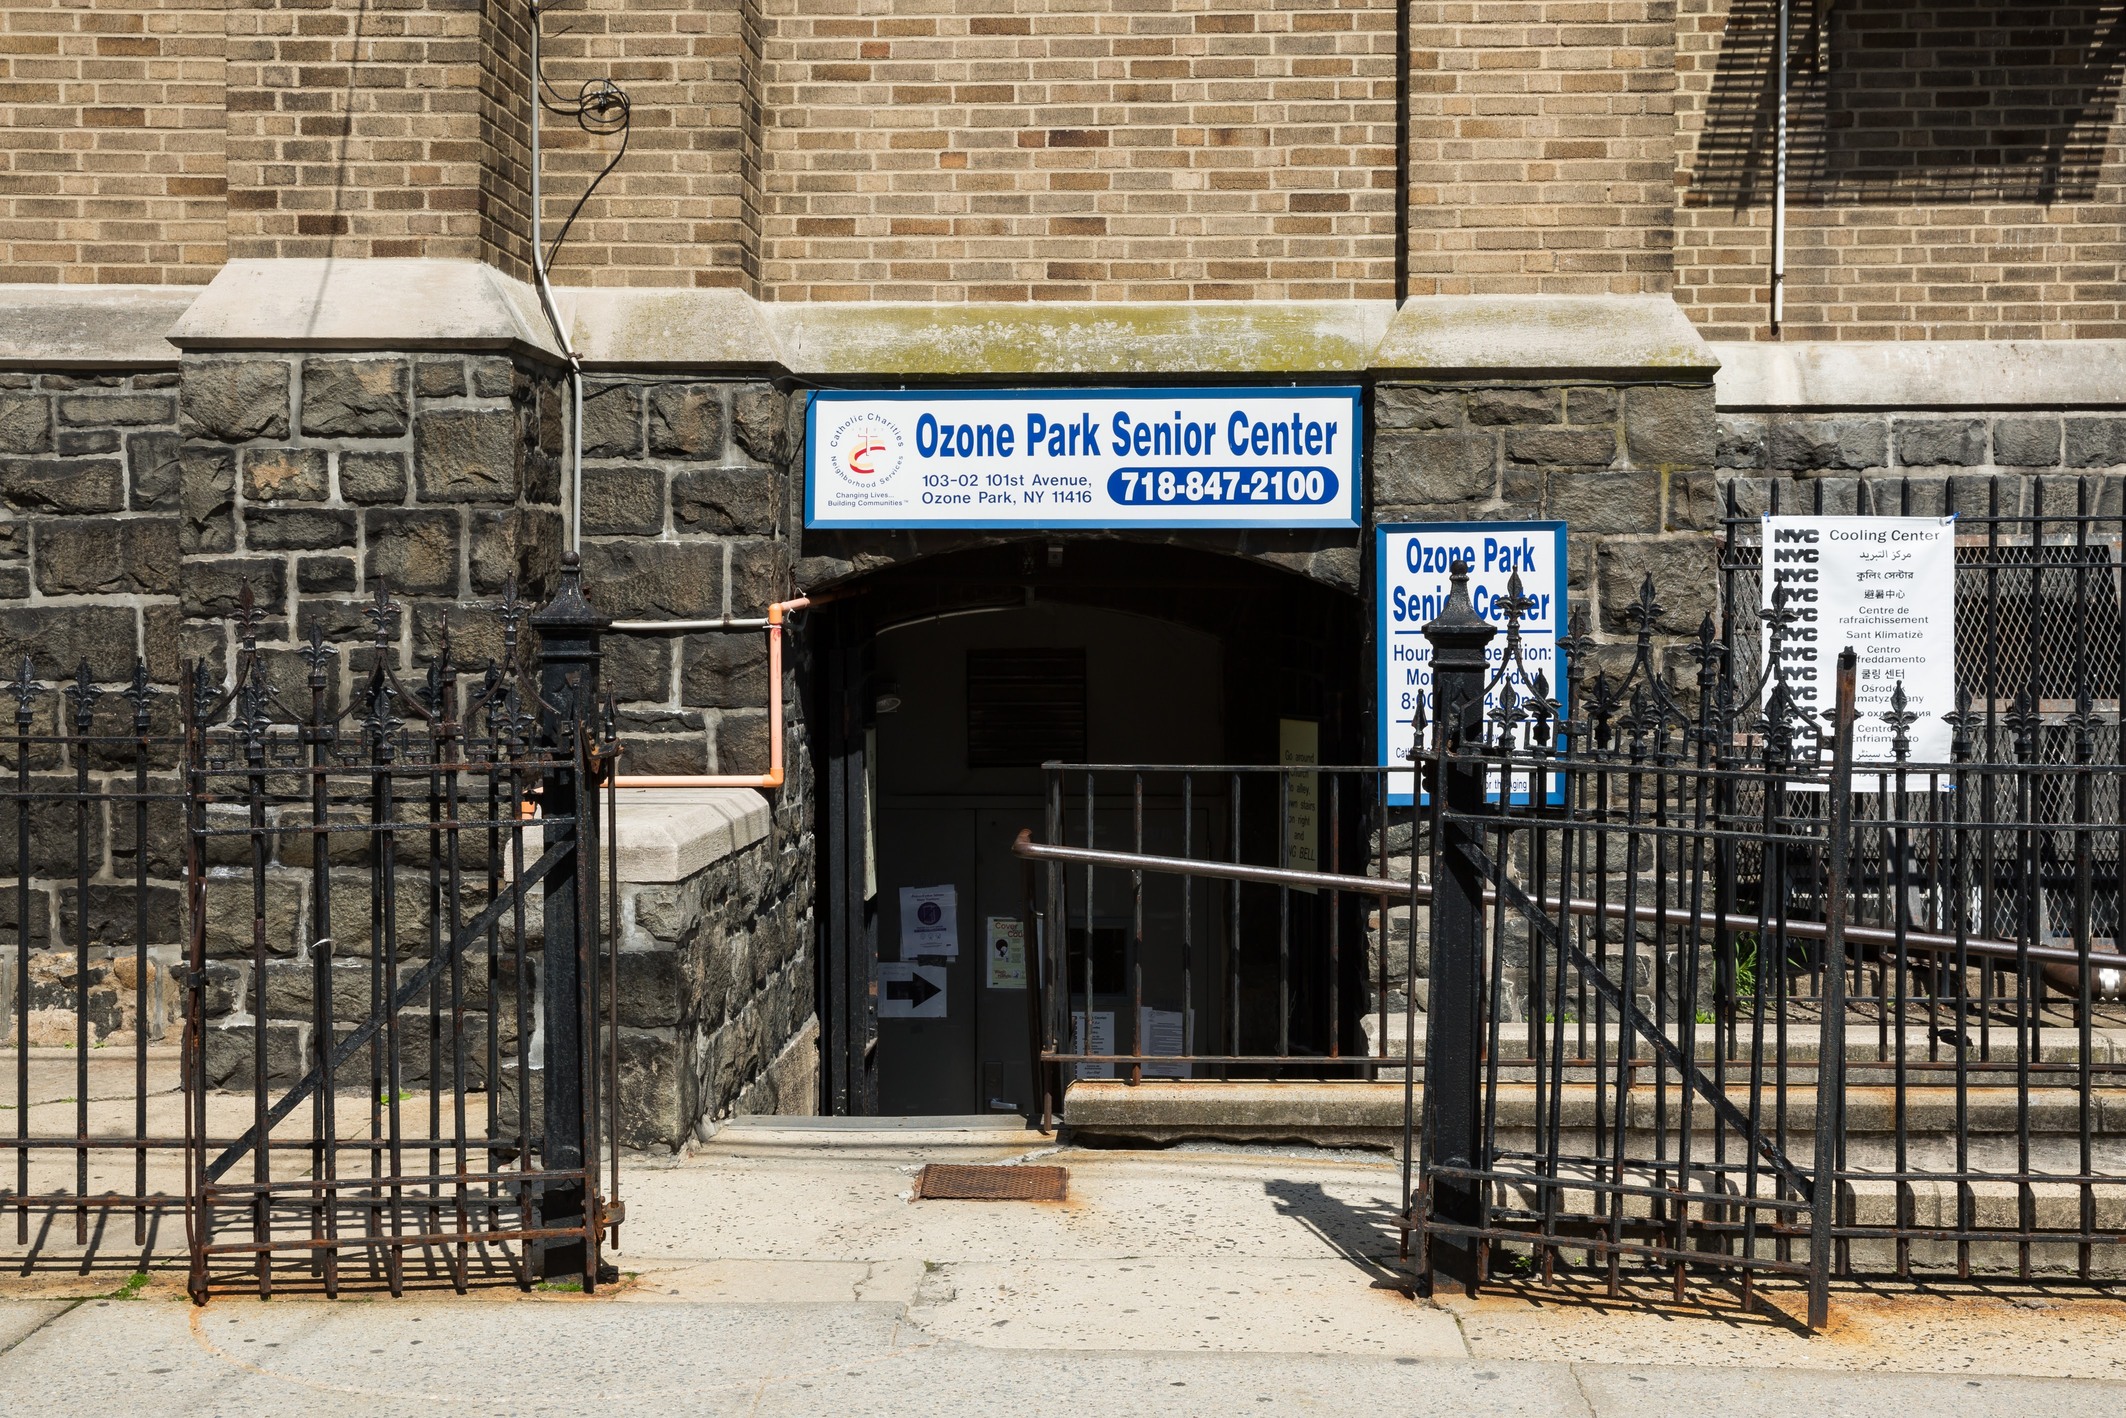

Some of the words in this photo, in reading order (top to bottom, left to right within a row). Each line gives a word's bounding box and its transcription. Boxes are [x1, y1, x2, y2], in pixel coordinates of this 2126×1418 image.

[830, 414, 864, 447] Catholic
[867, 412, 904, 447] Charities
[916, 412, 1015, 458] Ozone
[1027, 412, 1101, 457] Park
[1112, 410, 1216, 456] Senior
[1228, 410, 1338, 456] Center
[830, 455, 877, 488] Neighborhood
[879, 455, 904, 485] Services
[922, 474, 979, 487] 103-02
[985, 473, 1024, 487] 101st
[1032, 473, 1092, 488] Avenue,
[1121, 470, 1325, 501] 718-847-2100
[922, 491, 971, 504] Ozone
[979, 491, 1016, 505] Park,
[1024, 490, 1045, 503] NY
[1052, 490, 1092, 503] 11416
[1774, 529, 1819, 543] NYC
[1829, 530, 1887, 543] Cooling
[1891, 529, 1940, 541] Center
[1406, 537, 1475, 574] Ozone
[1484, 537, 1536, 573] Park
[1774, 548, 1819, 563] NYC
[1891, 550, 1912, 561] مركز
[1774, 568, 1818, 582] NYC
[1393, 585, 1452, 622] Seni
[1859, 606, 1894, 614] Centre
[1897, 606, 1910, 614] de
[1839, 615, 1929, 624] rafraîchissement
[1846, 630, 1871, 639] Sant
[1866, 645, 1901, 654] Centro
[1857, 655, 1926, 663] freddamento
[1861, 668, 1881, 679] 쿨링
[1884, 668, 1905, 679] 센터
[1861, 684, 1906, 693] Ośrod
[1294, 831, 1305, 840] and
[1299, 846, 1316, 861] BELL
